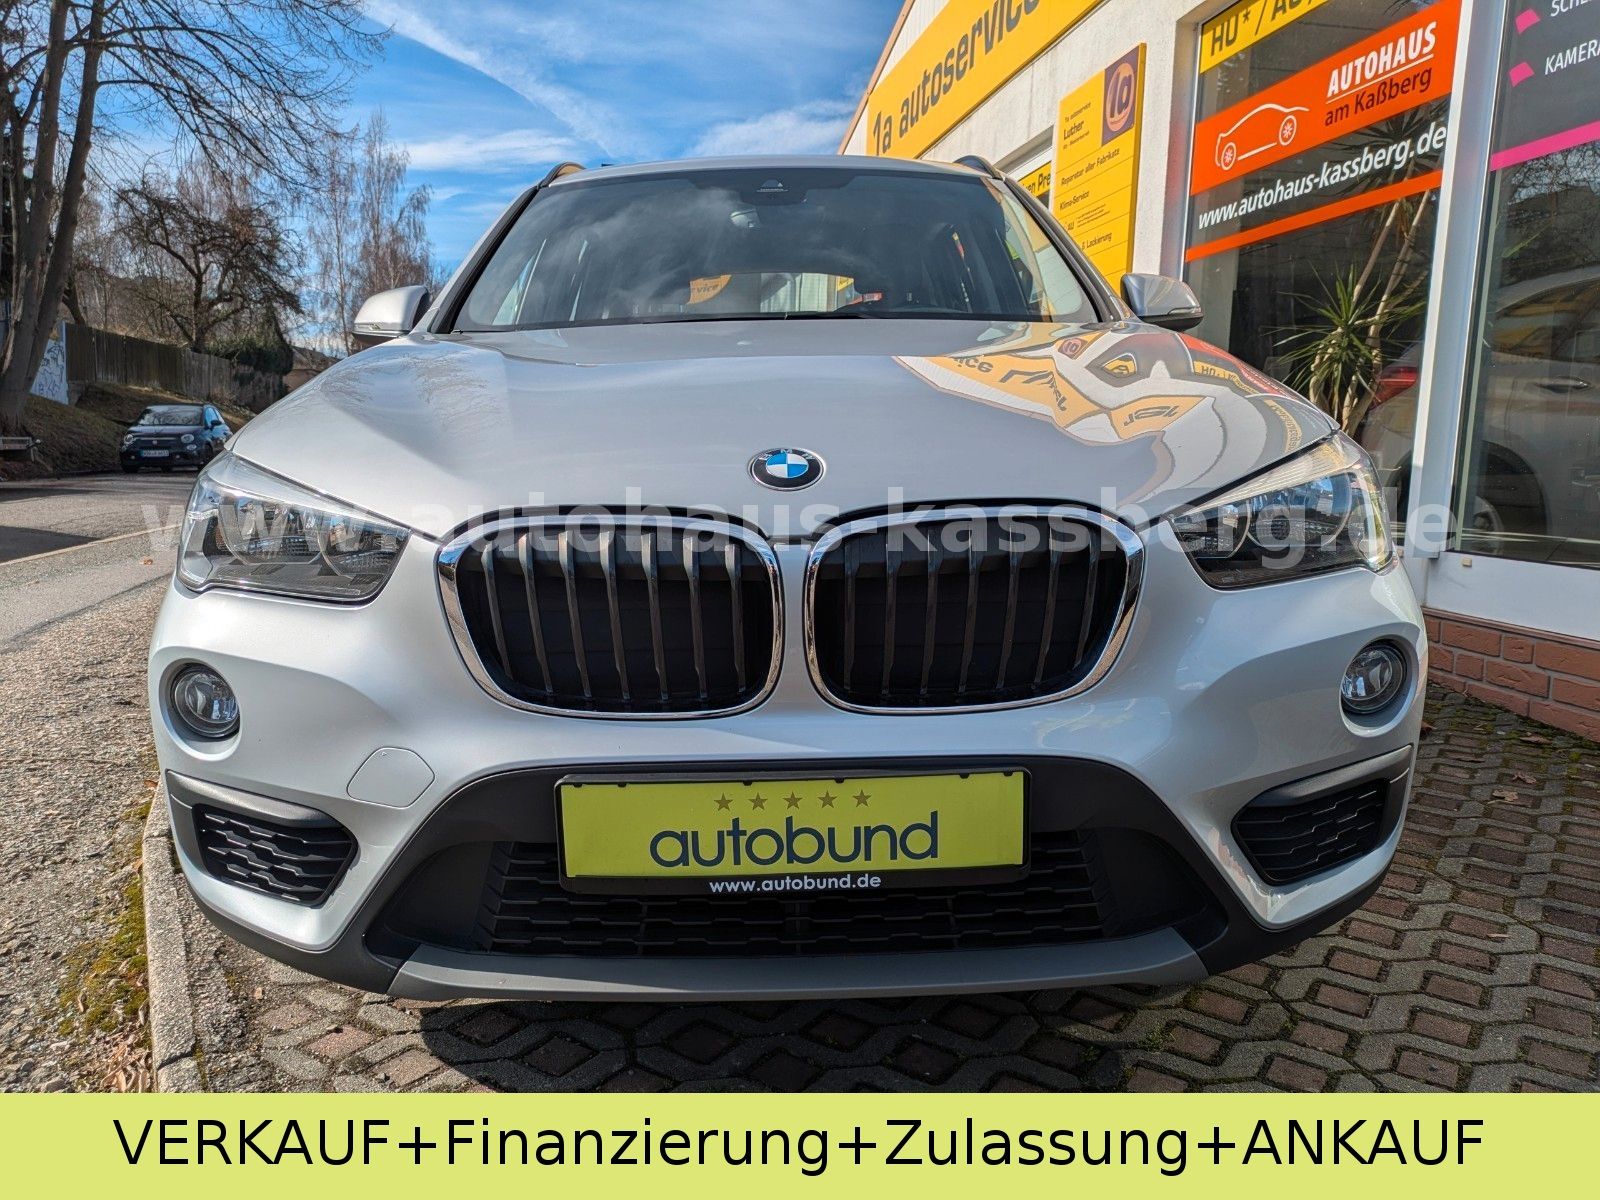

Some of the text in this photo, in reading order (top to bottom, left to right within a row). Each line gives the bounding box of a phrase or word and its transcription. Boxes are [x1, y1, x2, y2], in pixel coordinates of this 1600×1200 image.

[1327, 21, 1437, 98] AUTOHAUS
[1324, 67, 1433, 127] am Kaßberg
[873, 111, 893, 156] 1a
[1199, 121, 1448, 230] www.autohaus-kassberg.de
[649, 810, 939, 868] autobund
[709, 873, 883, 894] www.autobund.de
